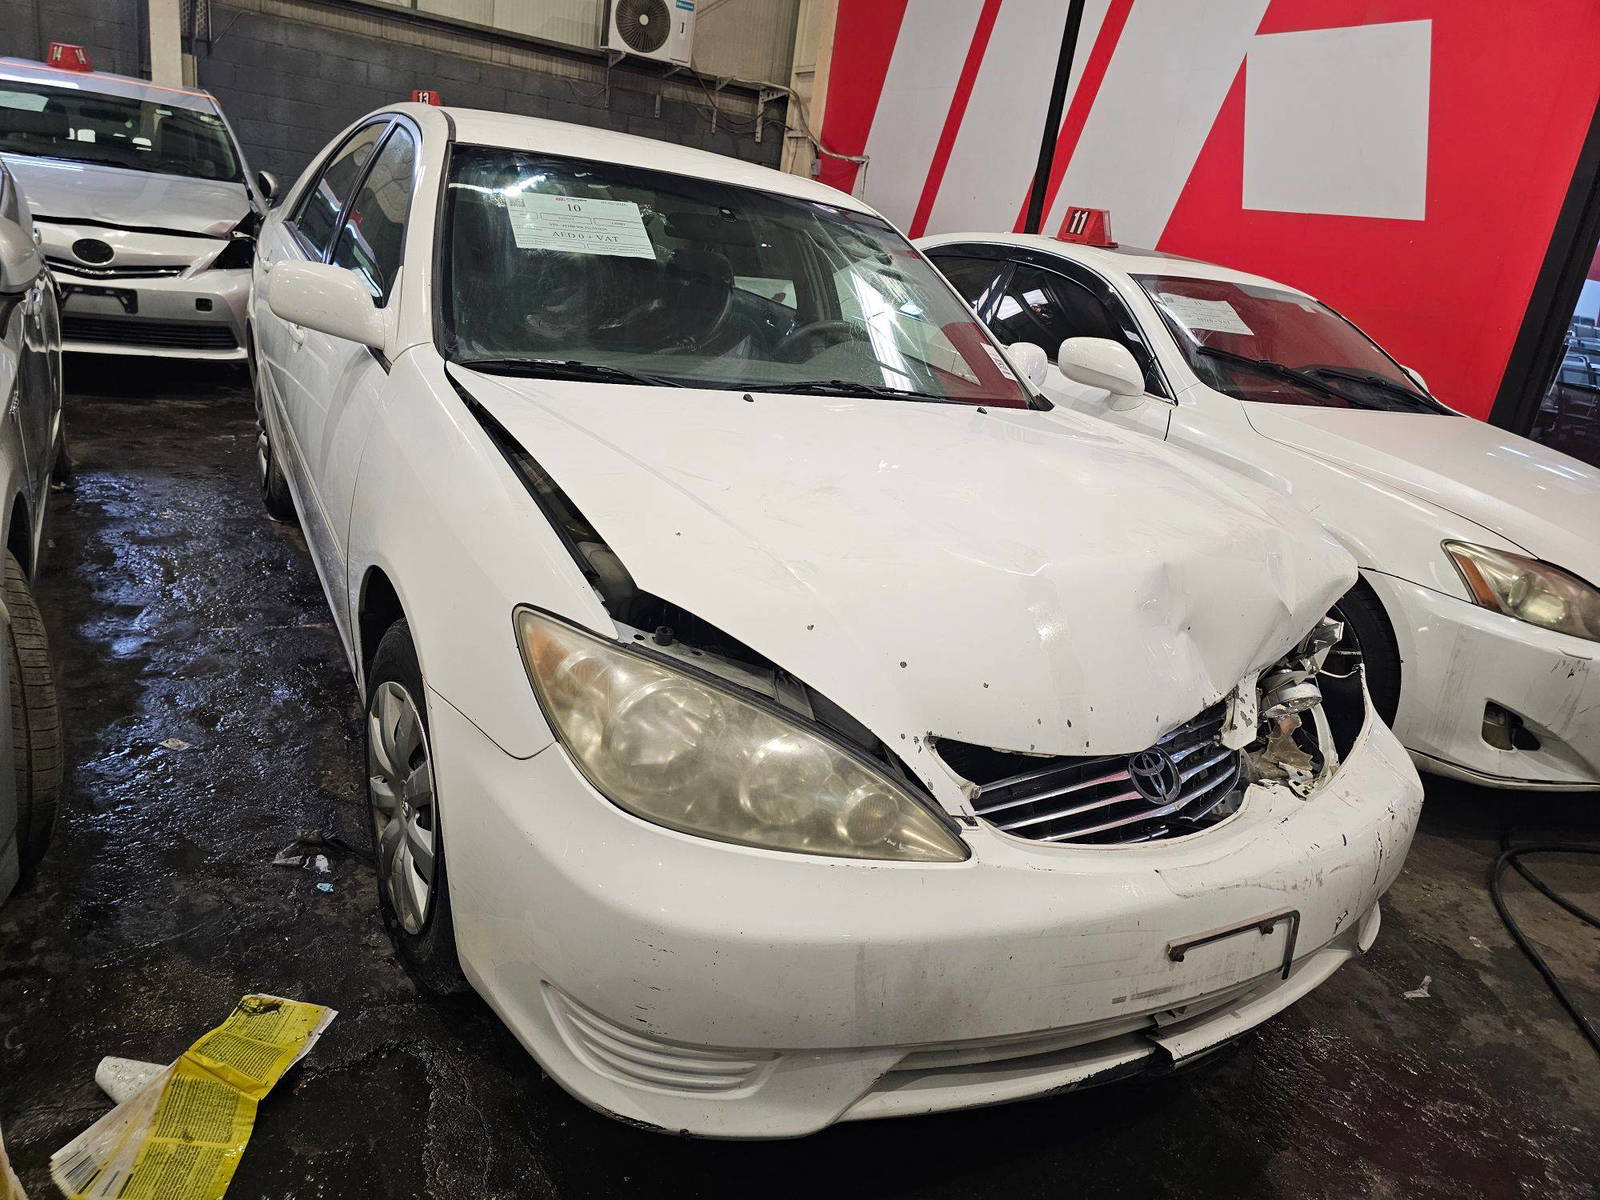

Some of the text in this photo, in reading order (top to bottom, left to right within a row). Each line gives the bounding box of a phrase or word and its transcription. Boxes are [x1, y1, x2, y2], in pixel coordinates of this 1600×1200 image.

[53, 46, 63, 61] 14
[418, 91, 429, 104] 13
[567, 203, 582, 212] 10
[1069, 210, 1089, 235] 11
[552, 231, 576, 239] AED
[596, 233, 619, 242] VAT
